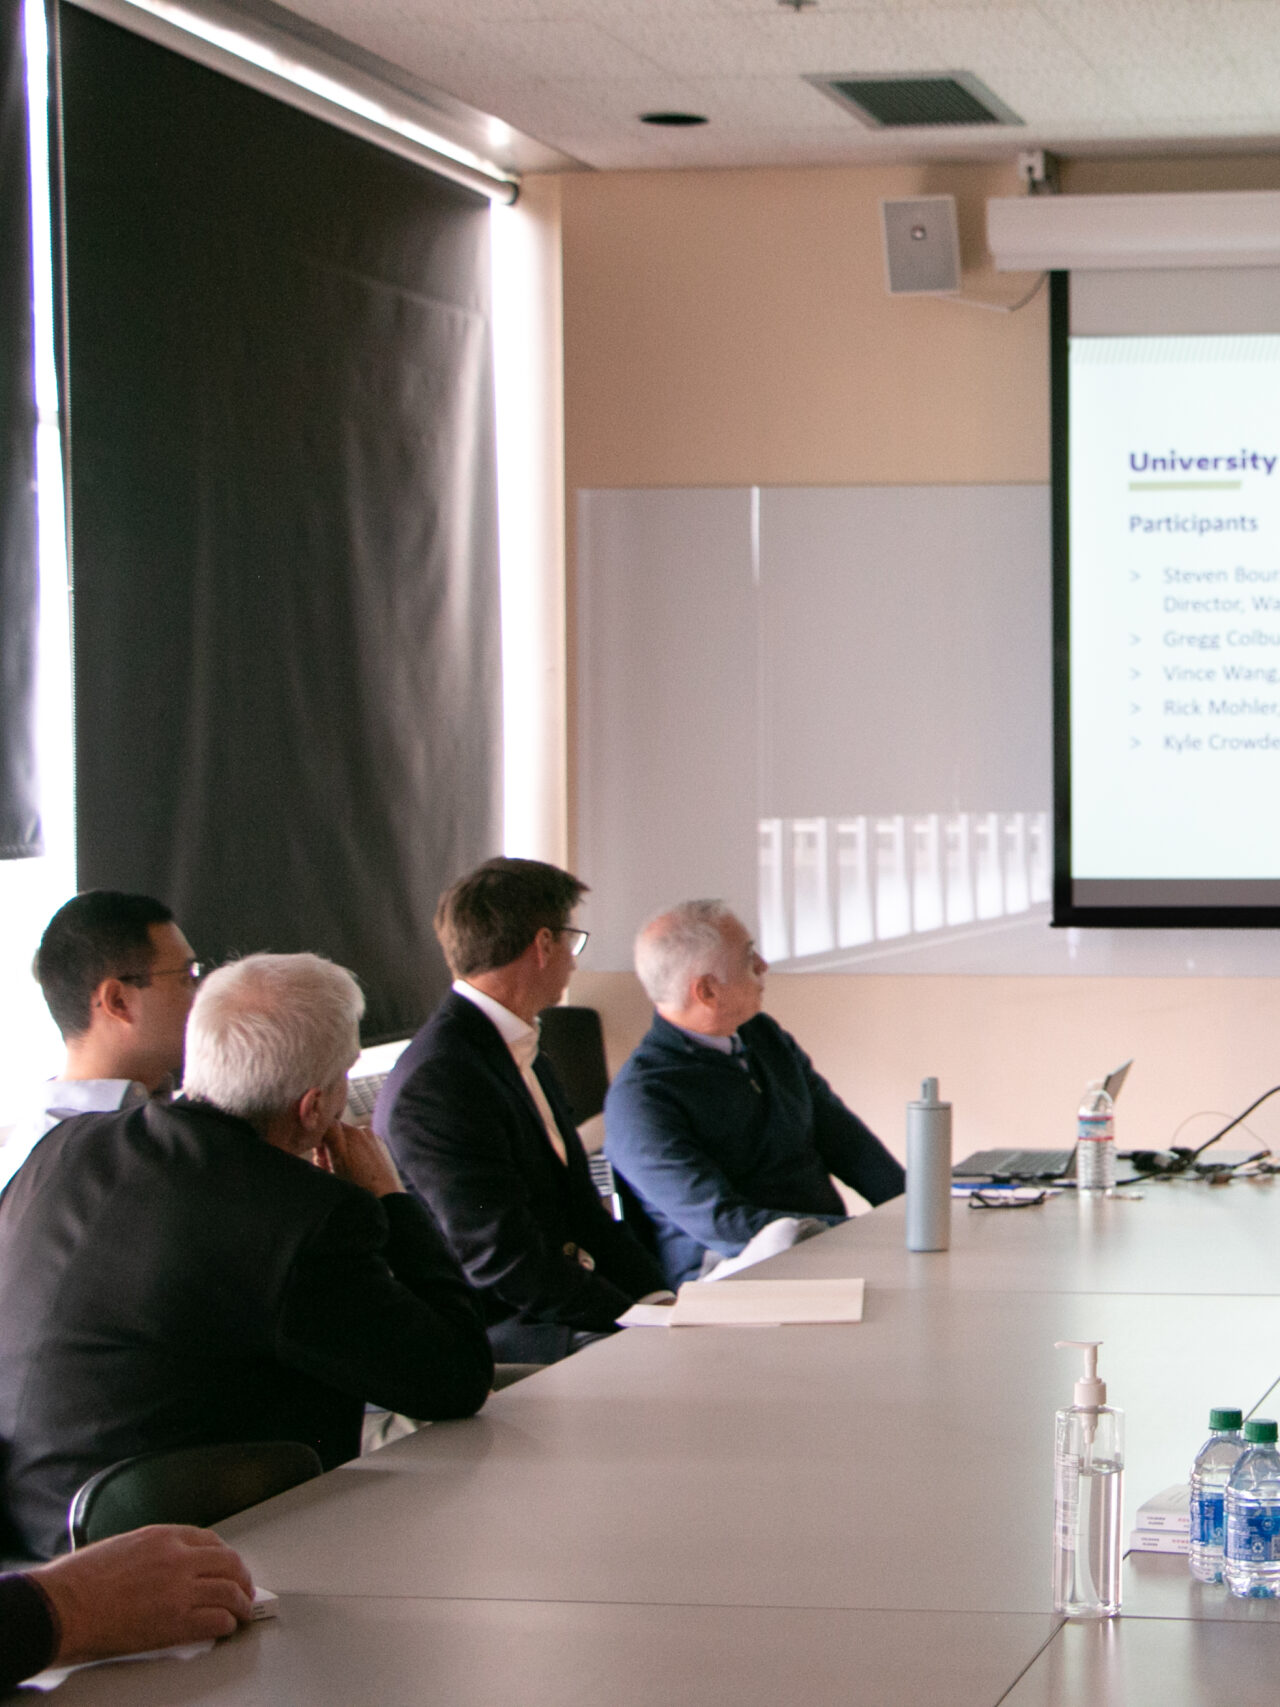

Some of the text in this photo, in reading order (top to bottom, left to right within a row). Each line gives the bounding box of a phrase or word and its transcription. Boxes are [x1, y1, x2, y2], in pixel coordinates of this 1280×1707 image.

[1129, 449, 1277, 475] University
[1128, 514, 1258, 535] Participants
[1163, 566, 1228, 584] Steven
[1162, 630, 1221, 651] Gregg
[1163, 665, 1217, 682] Vince
[1163, 698, 1202, 716] Rick
[1163, 733, 1202, 754] Kyle
